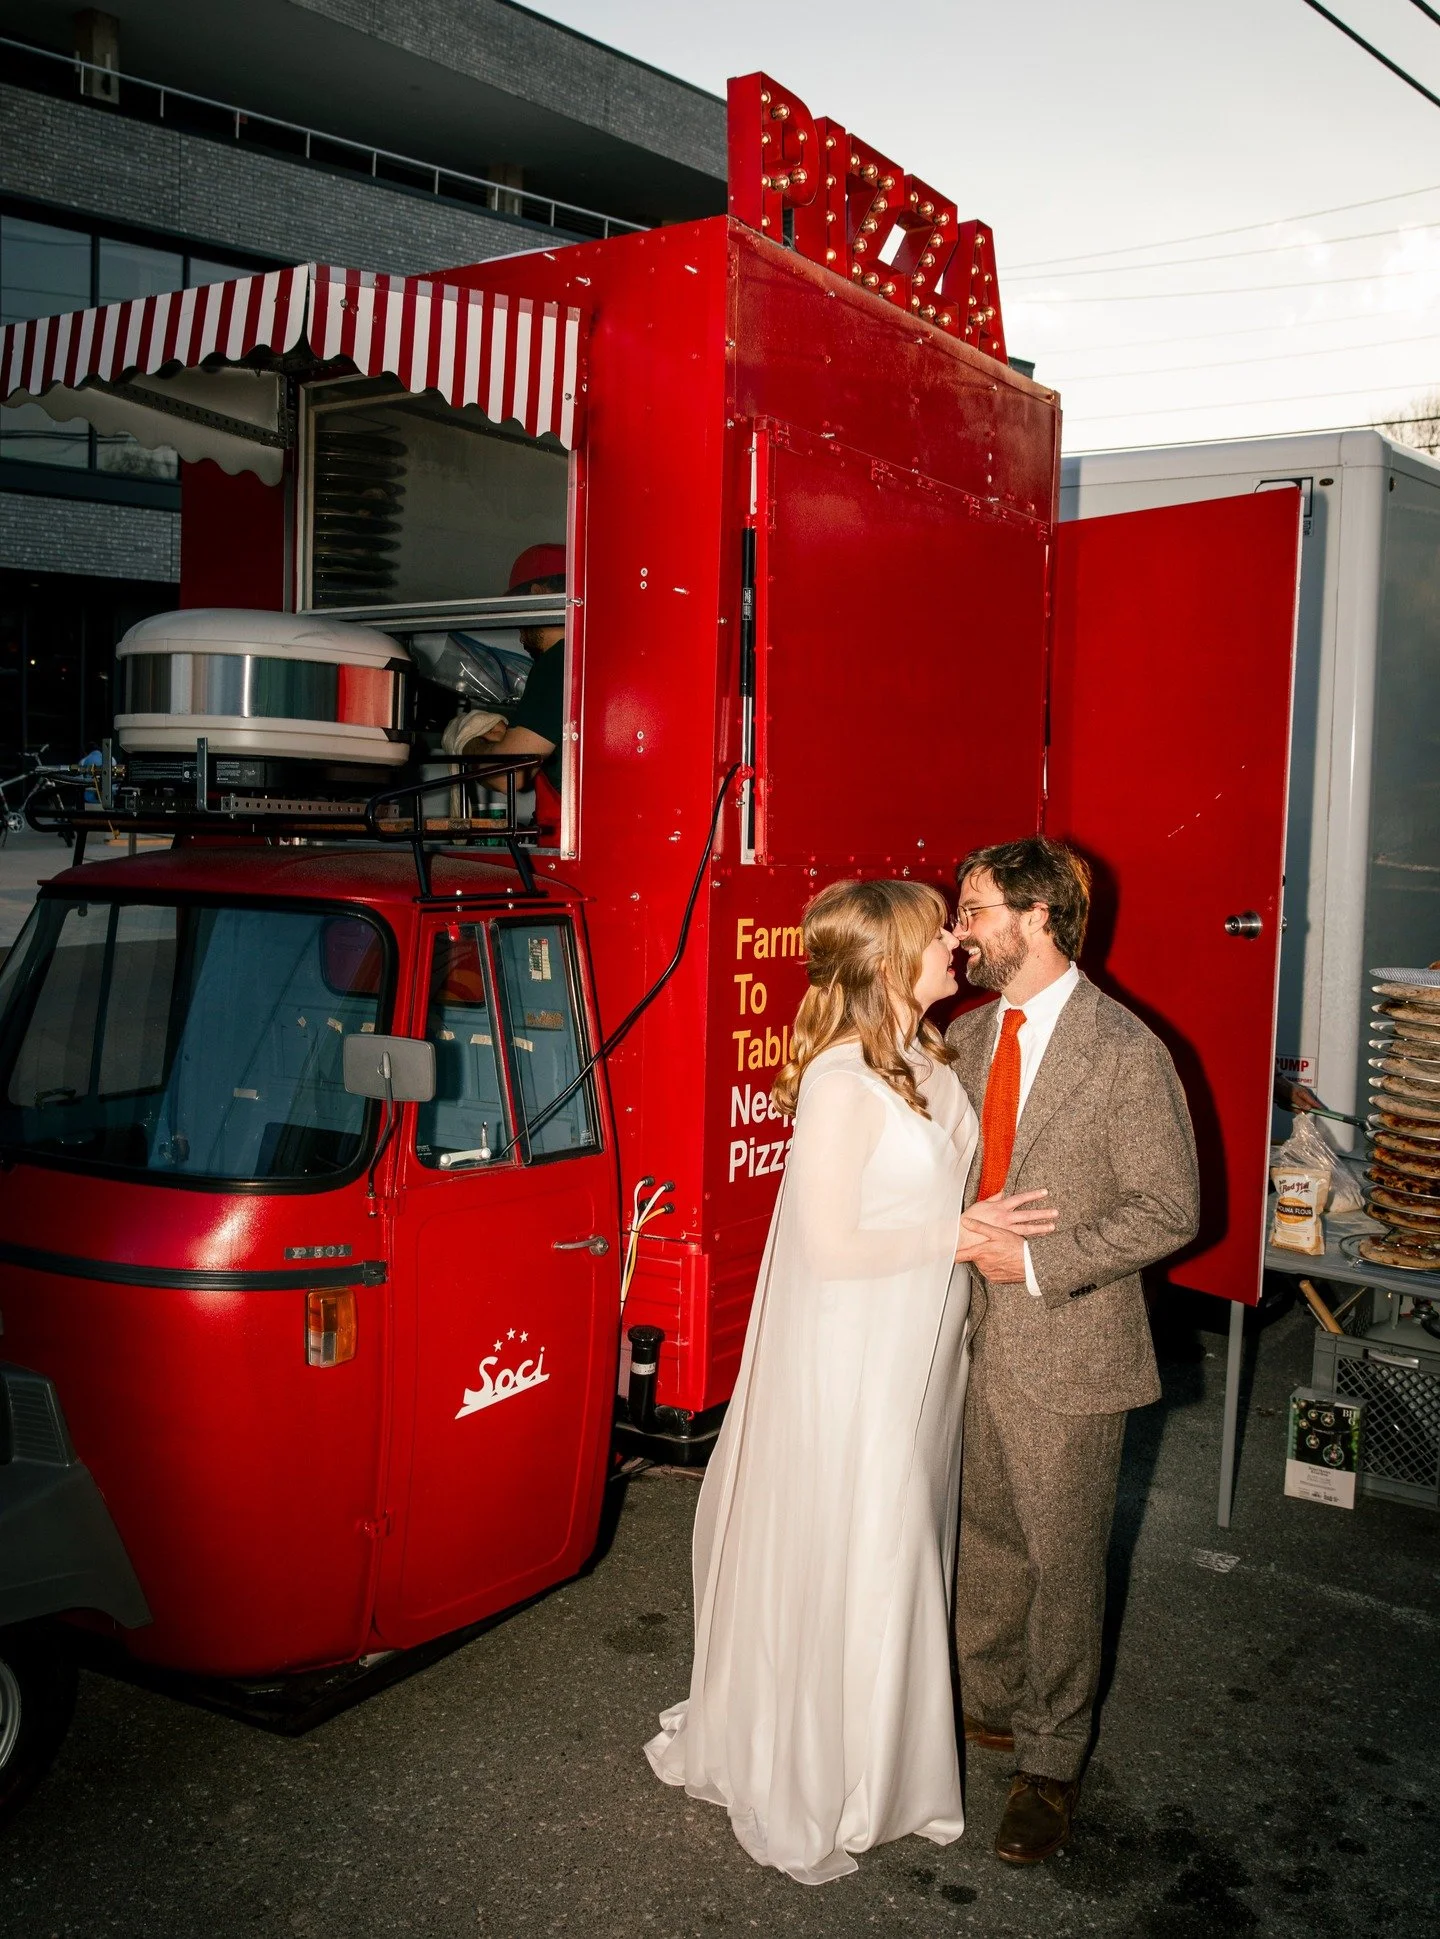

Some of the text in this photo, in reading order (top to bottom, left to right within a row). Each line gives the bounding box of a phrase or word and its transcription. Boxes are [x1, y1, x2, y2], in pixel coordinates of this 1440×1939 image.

[727, 71, 1009, 366] PIZZA
[736, 918, 804, 960] Farm
[733, 973, 768, 1015] To
[455, 1346, 550, 1420] Soci
